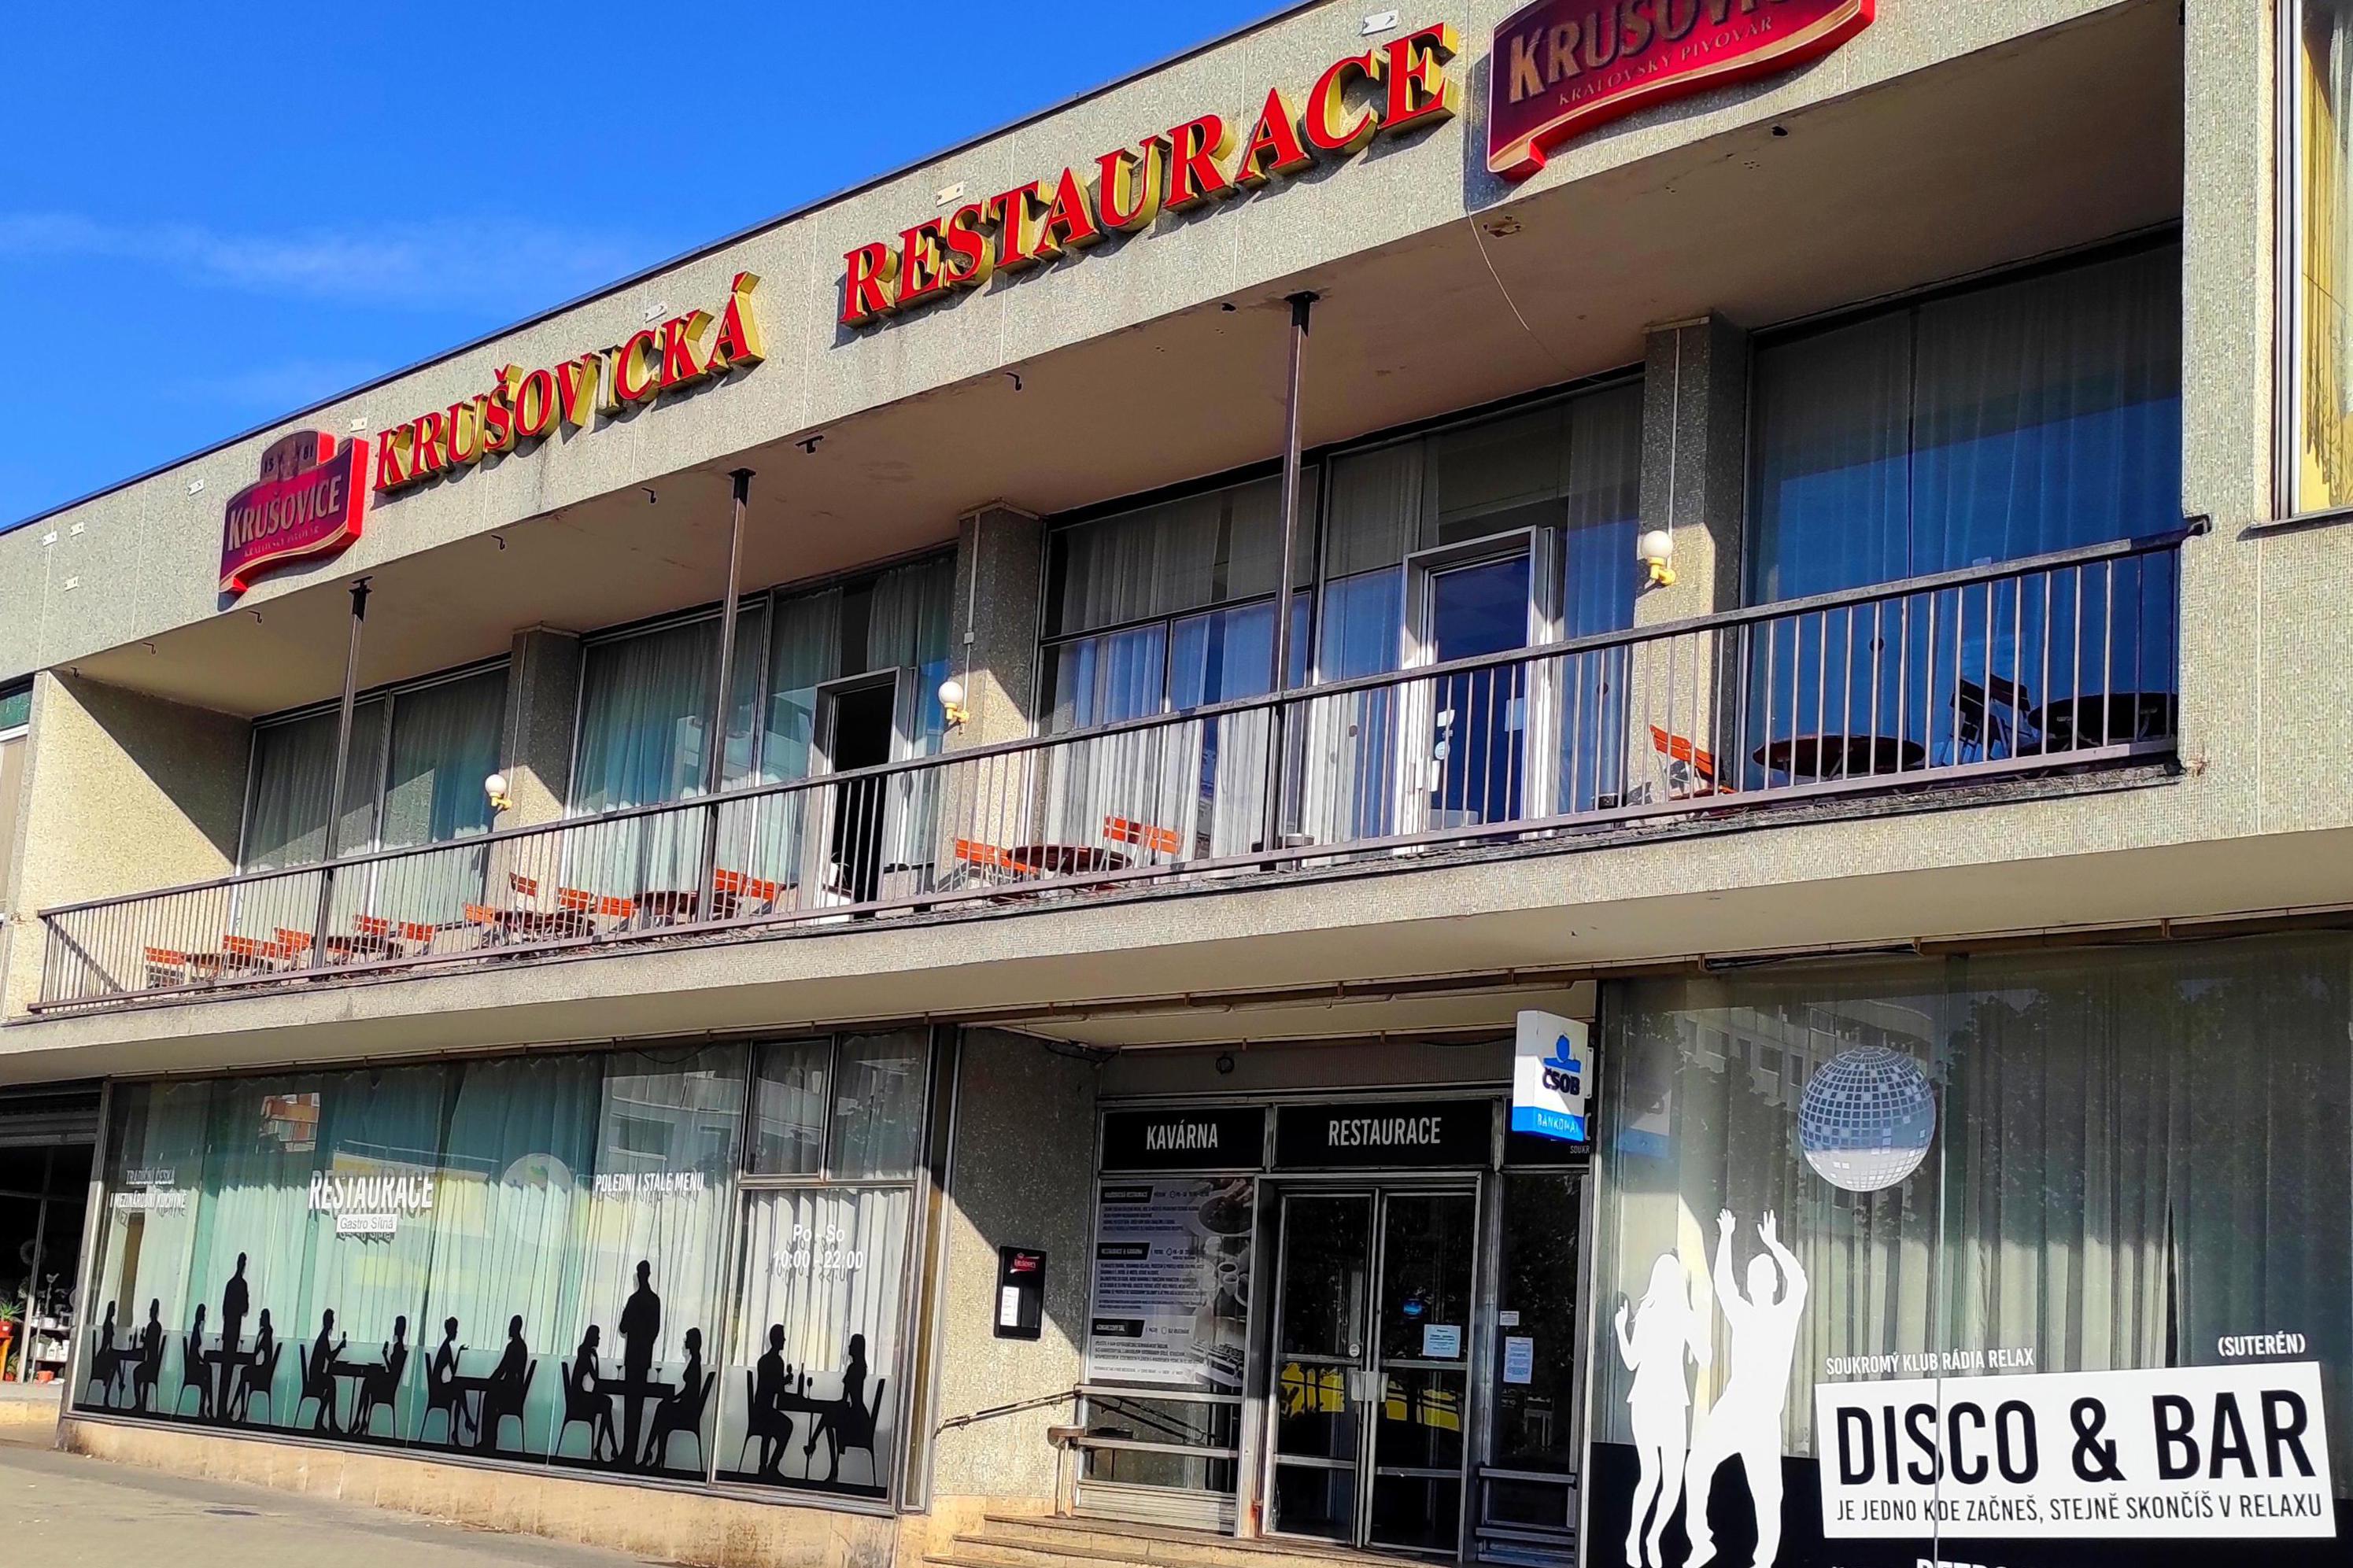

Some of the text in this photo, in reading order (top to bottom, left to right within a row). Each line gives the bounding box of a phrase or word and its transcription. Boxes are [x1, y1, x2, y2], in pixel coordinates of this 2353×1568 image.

[839, 21, 1457, 327] RESTAURACE
[373, 271, 765, 492] KRUŠOVICKÁ
[227, 474, 342, 551] KRUŠOVICE
[1542, 1067, 1580, 1095] ČSOB
[1147, 1119, 1218, 1149] KAVÁRNA
[1328, 1117, 1442, 1146] RESTAURACE
[1570, 1145, 1590, 1153] SOUKR
[308, 1170, 436, 1209] RESTAURACE
[674, 1171, 705, 1191] MENU
[340, 1217, 368, 1230] Gastro
[792, 1224, 812, 1241] Po
[826, 1224, 845, 1241] So
[773, 1250, 811, 1268] 10:00
[2218, 1330, 2306, 1356] (SUTERÉN)
[1826, 1348, 2034, 1374] SOUKROMÝ KLUB RÁDIA RELAX
[1837, 1389, 2317, 1485] DISCO & BAR
[1837, 1490, 2322, 1524] JE JEDNO KDE ZAČNEŠ, STEJNĚ SKONČÍŠ V RELAXU
